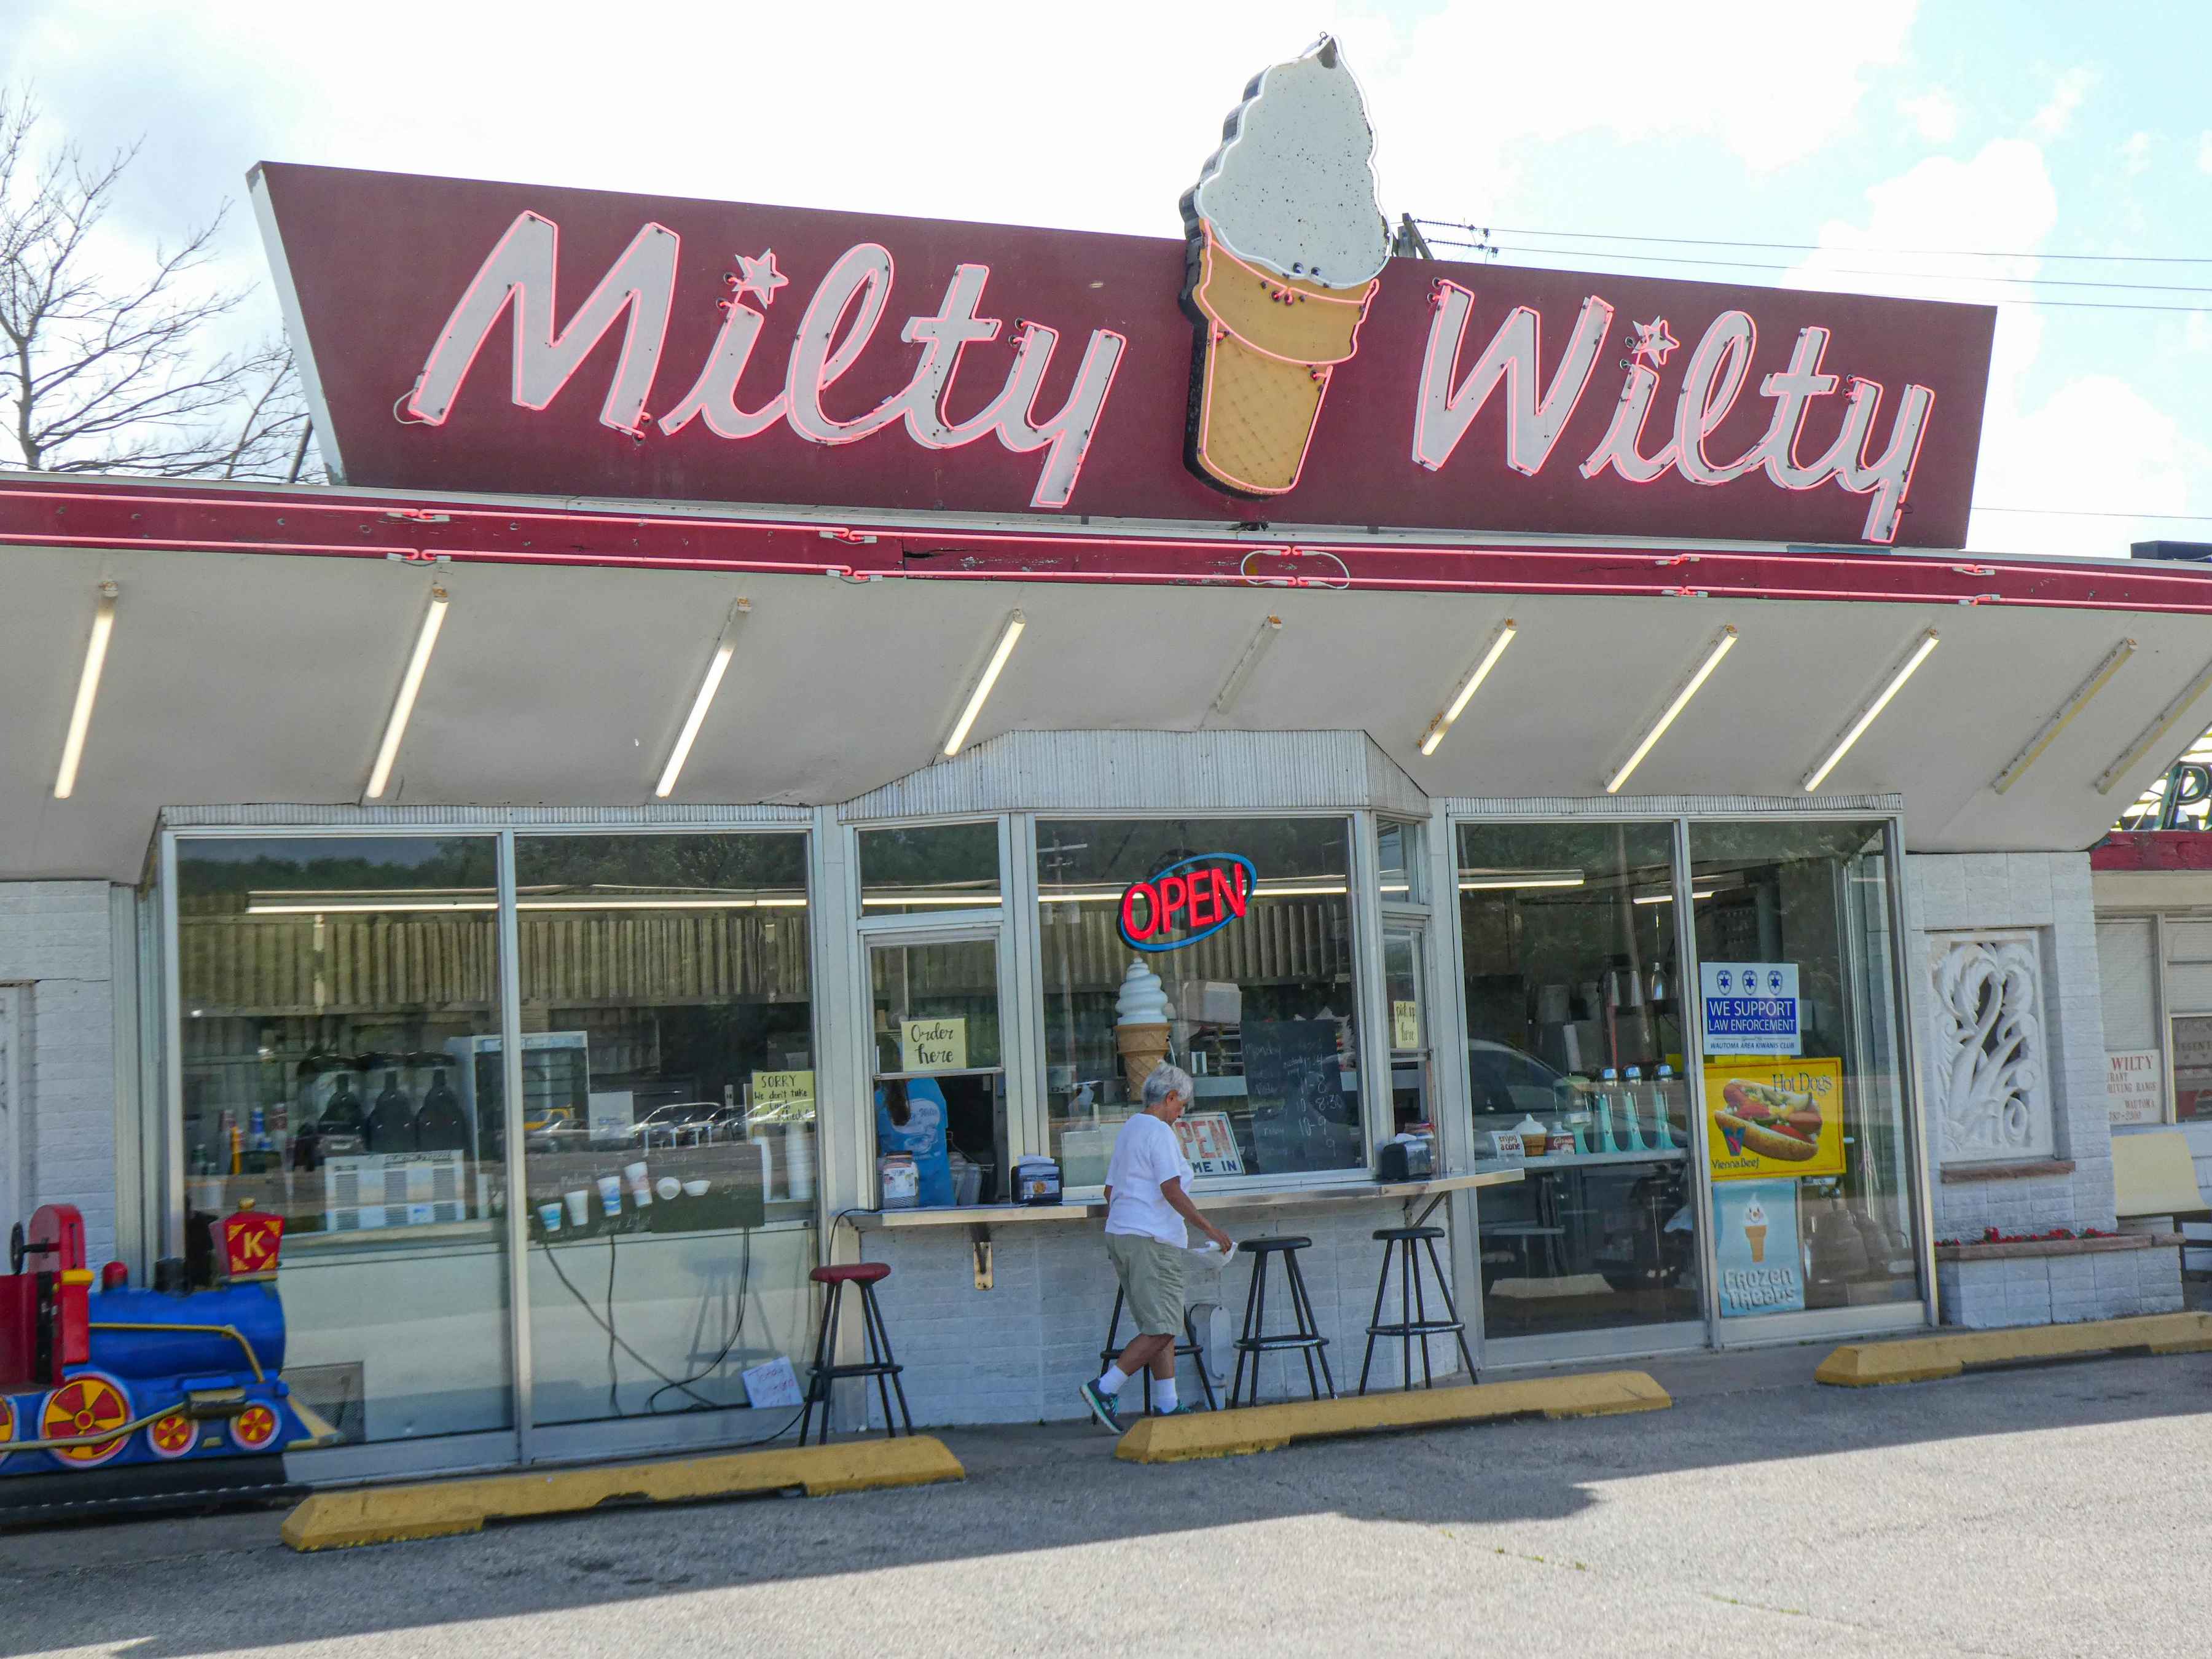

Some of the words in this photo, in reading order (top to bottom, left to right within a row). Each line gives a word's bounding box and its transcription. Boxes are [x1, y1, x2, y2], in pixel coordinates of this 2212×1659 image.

[408, 210, 1126, 508] Milty
[1412, 279, 1935, 543] Wilty
[2158, 761, 2212, 831] P
[1122, 863, 1246, 941] OPEN
[1709, 1001, 1730, 1016] WE
[1734, 1000, 1793, 1016] SUPPORT
[911, 1022, 953, 1042] Order
[1709, 1020, 1728, 1030] LAW
[1731, 1019, 1795, 1031] ENFORCEMENT
[914, 1043, 954, 1064] here
[2111, 1056, 2153, 1070] WILTY
[761, 1074, 797, 1088] SORRY
[1772, 1072, 1795, 1092] Hot
[754, 1091, 764, 1100] We
[769, 1090, 787, 1099] don't
[790, 1088, 808, 1097] take
[1175, 1120, 1234, 1160] PEN
[1499, 1135, 1518, 1143] enjoy
[1191, 1161, 1214, 1173] ME
[1221, 1160, 1237, 1171] IN
[1711, 1158, 1740, 1169] Vienna
[1741, 1157, 1760, 1168] Beef
[244, 1230, 266, 1259] K
